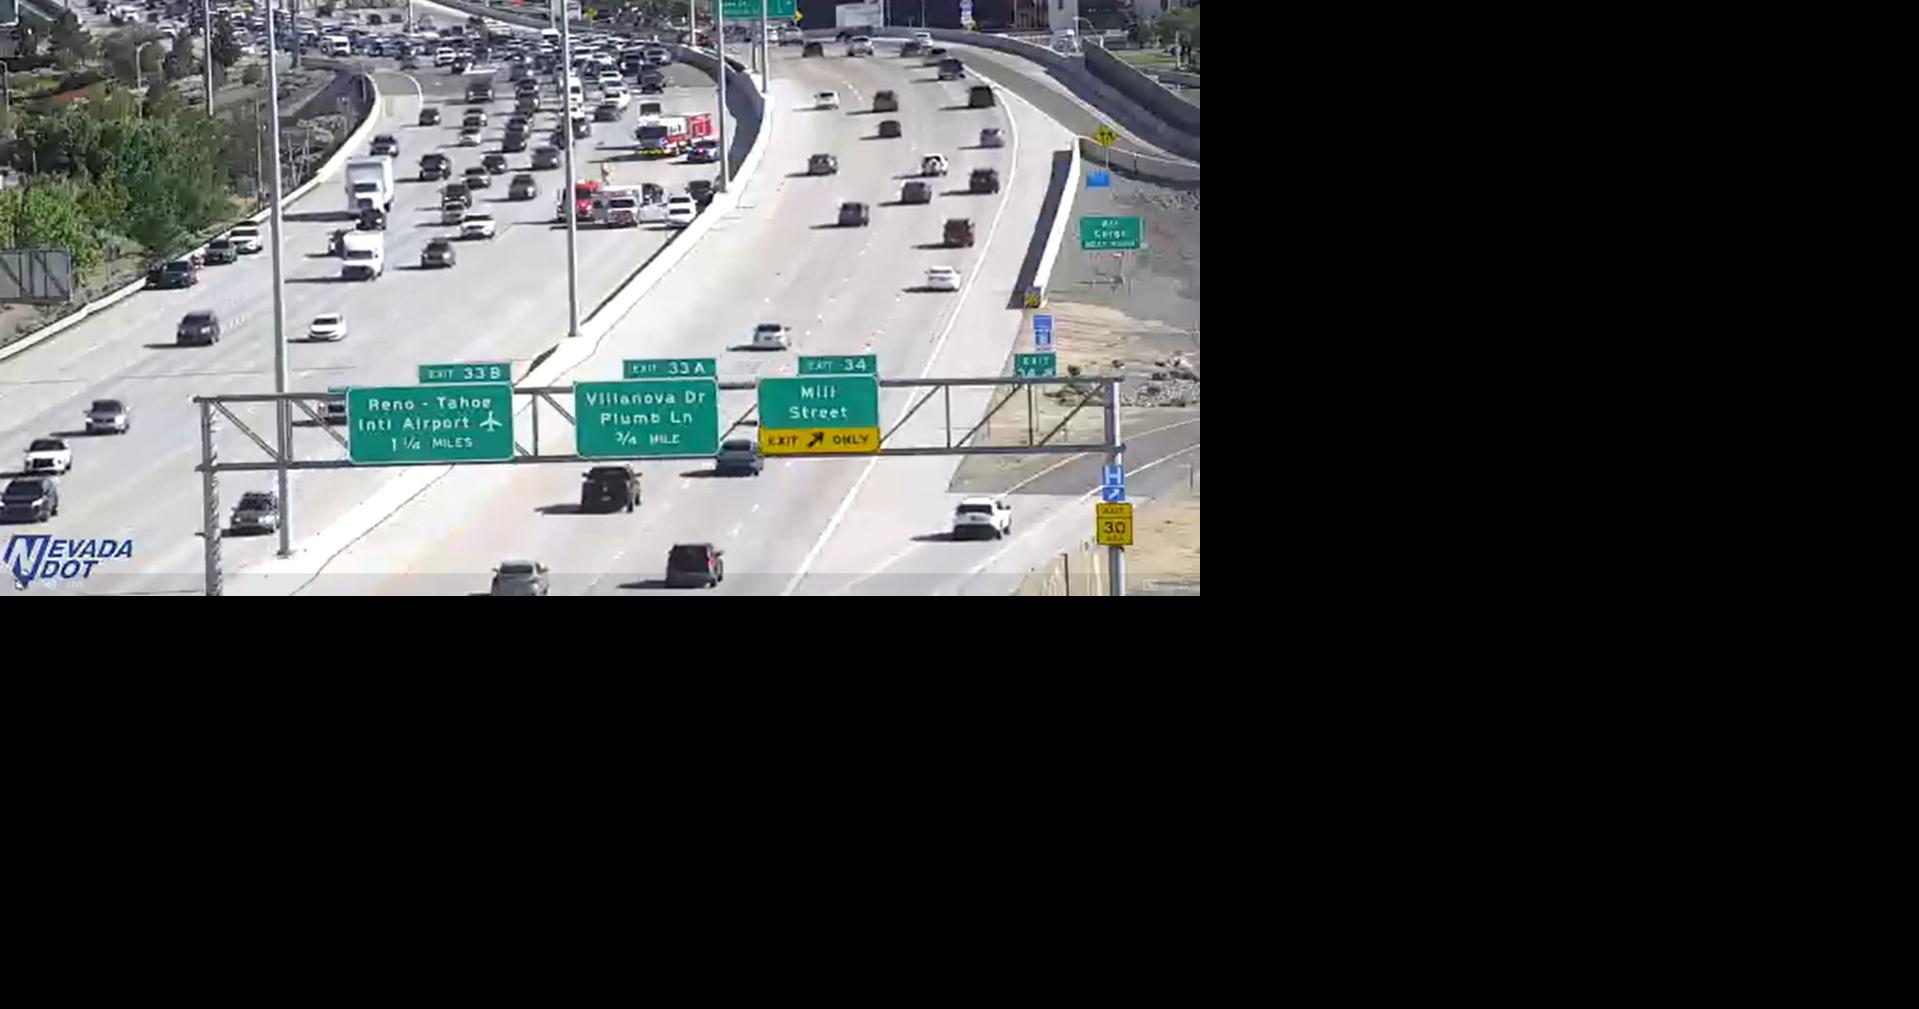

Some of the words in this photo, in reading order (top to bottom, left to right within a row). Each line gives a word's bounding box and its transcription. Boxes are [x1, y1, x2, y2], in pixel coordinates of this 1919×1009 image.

[632, 363, 657, 374] EXIT
[844, 358, 867, 371] 34
[428, 369, 454, 379] EXIT
[585, 391, 676, 406] Villanova
[685, 390, 706, 404] Dr
[801, 385, 837, 400] Mill
[368, 398, 415, 412] Reno
[436, 396, 492, 410] Tahoe
[600, 412, 661, 426] Plumb
[670, 410, 693, 424] Ln
[788, 405, 848, 421] Street
[358, 418, 392, 432] Intl
[402, 416, 470, 432] Airport
[431, 437, 473, 450] MILES
[649, 433, 681, 446] MILE
[767, 434, 799, 446] EXIT
[832, 434, 869, 446] ONLY
[1105, 466, 1122, 485] H
[1104, 520, 1126, 534] 30
